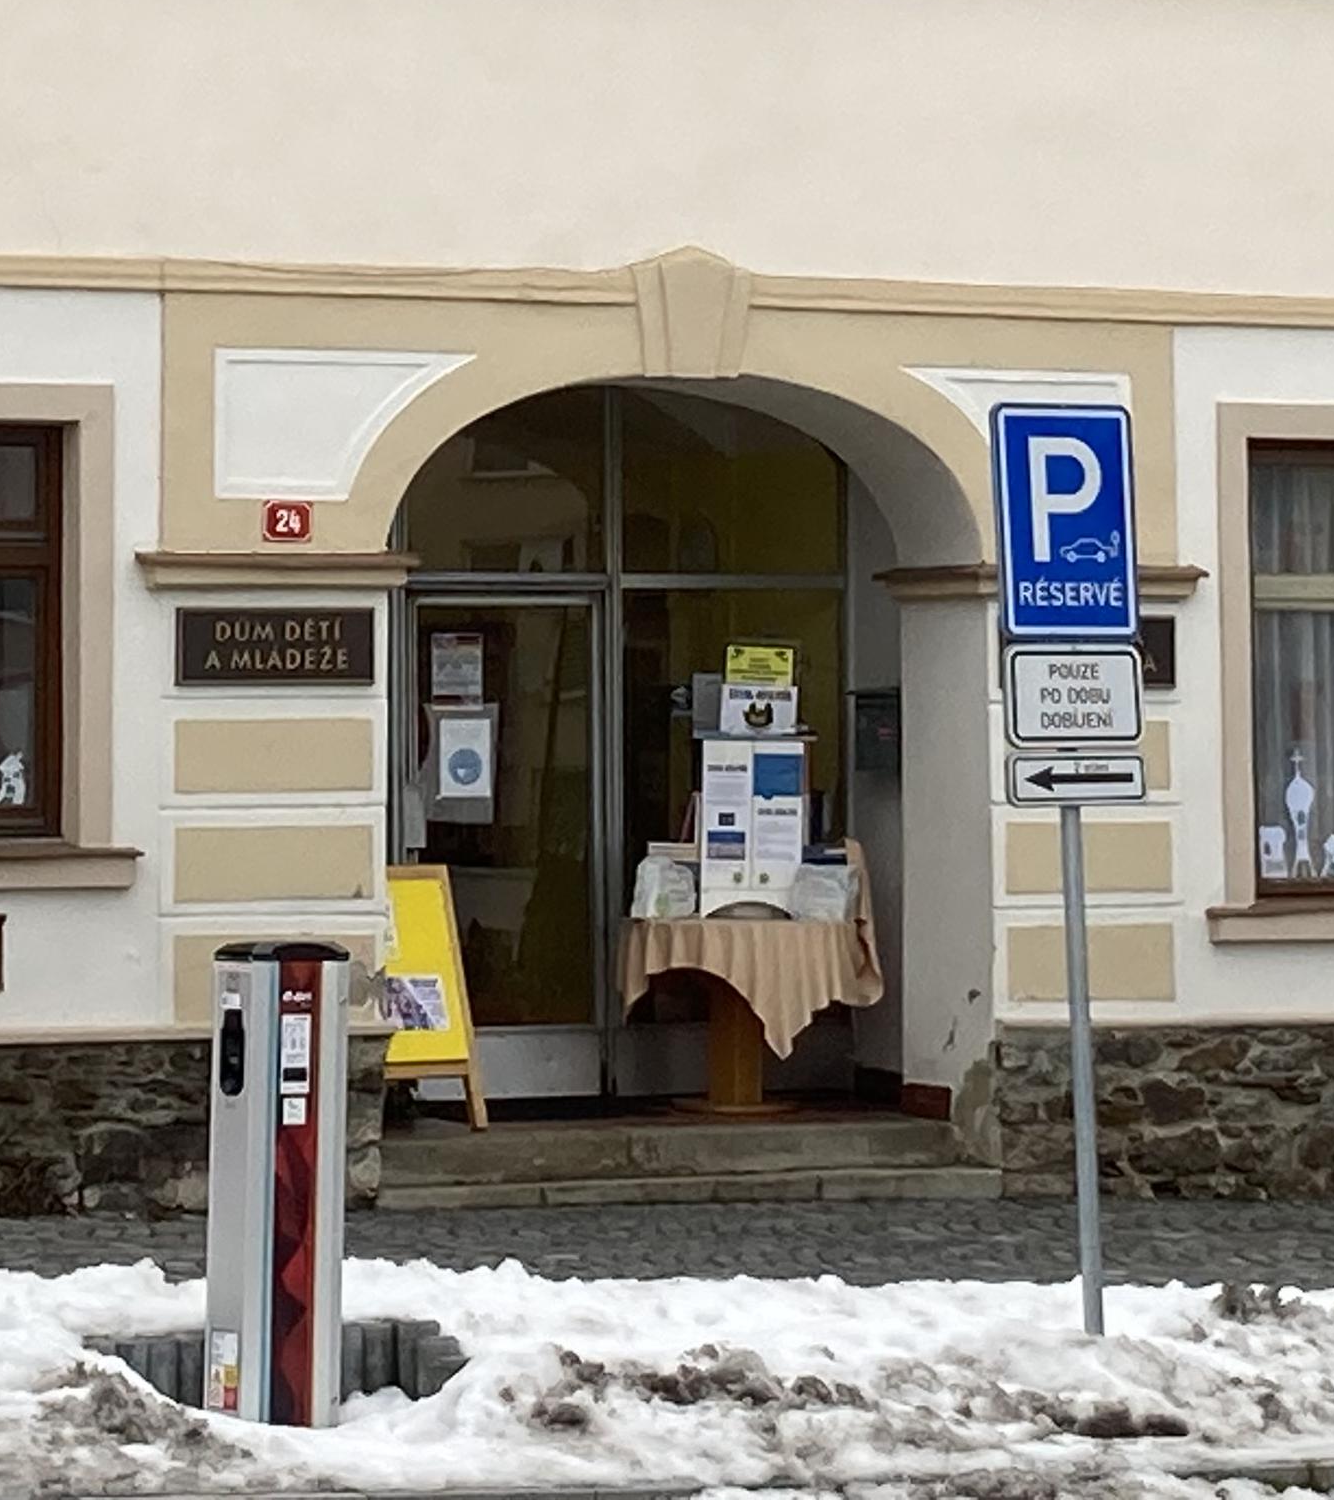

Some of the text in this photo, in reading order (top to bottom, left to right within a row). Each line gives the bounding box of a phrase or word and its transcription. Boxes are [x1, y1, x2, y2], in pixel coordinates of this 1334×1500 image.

[1028, 435, 1102, 563] P
[275, 509, 301, 534] 24
[1018, 575, 1123, 607] RÉSERVÉ
[284, 617, 343, 642] DĚTÍ
[204, 644, 350, 670] A MLÁDEŽE
[1048, 663, 1100, 680] POUZE
[1040, 687, 1111, 704] PO DOBU
